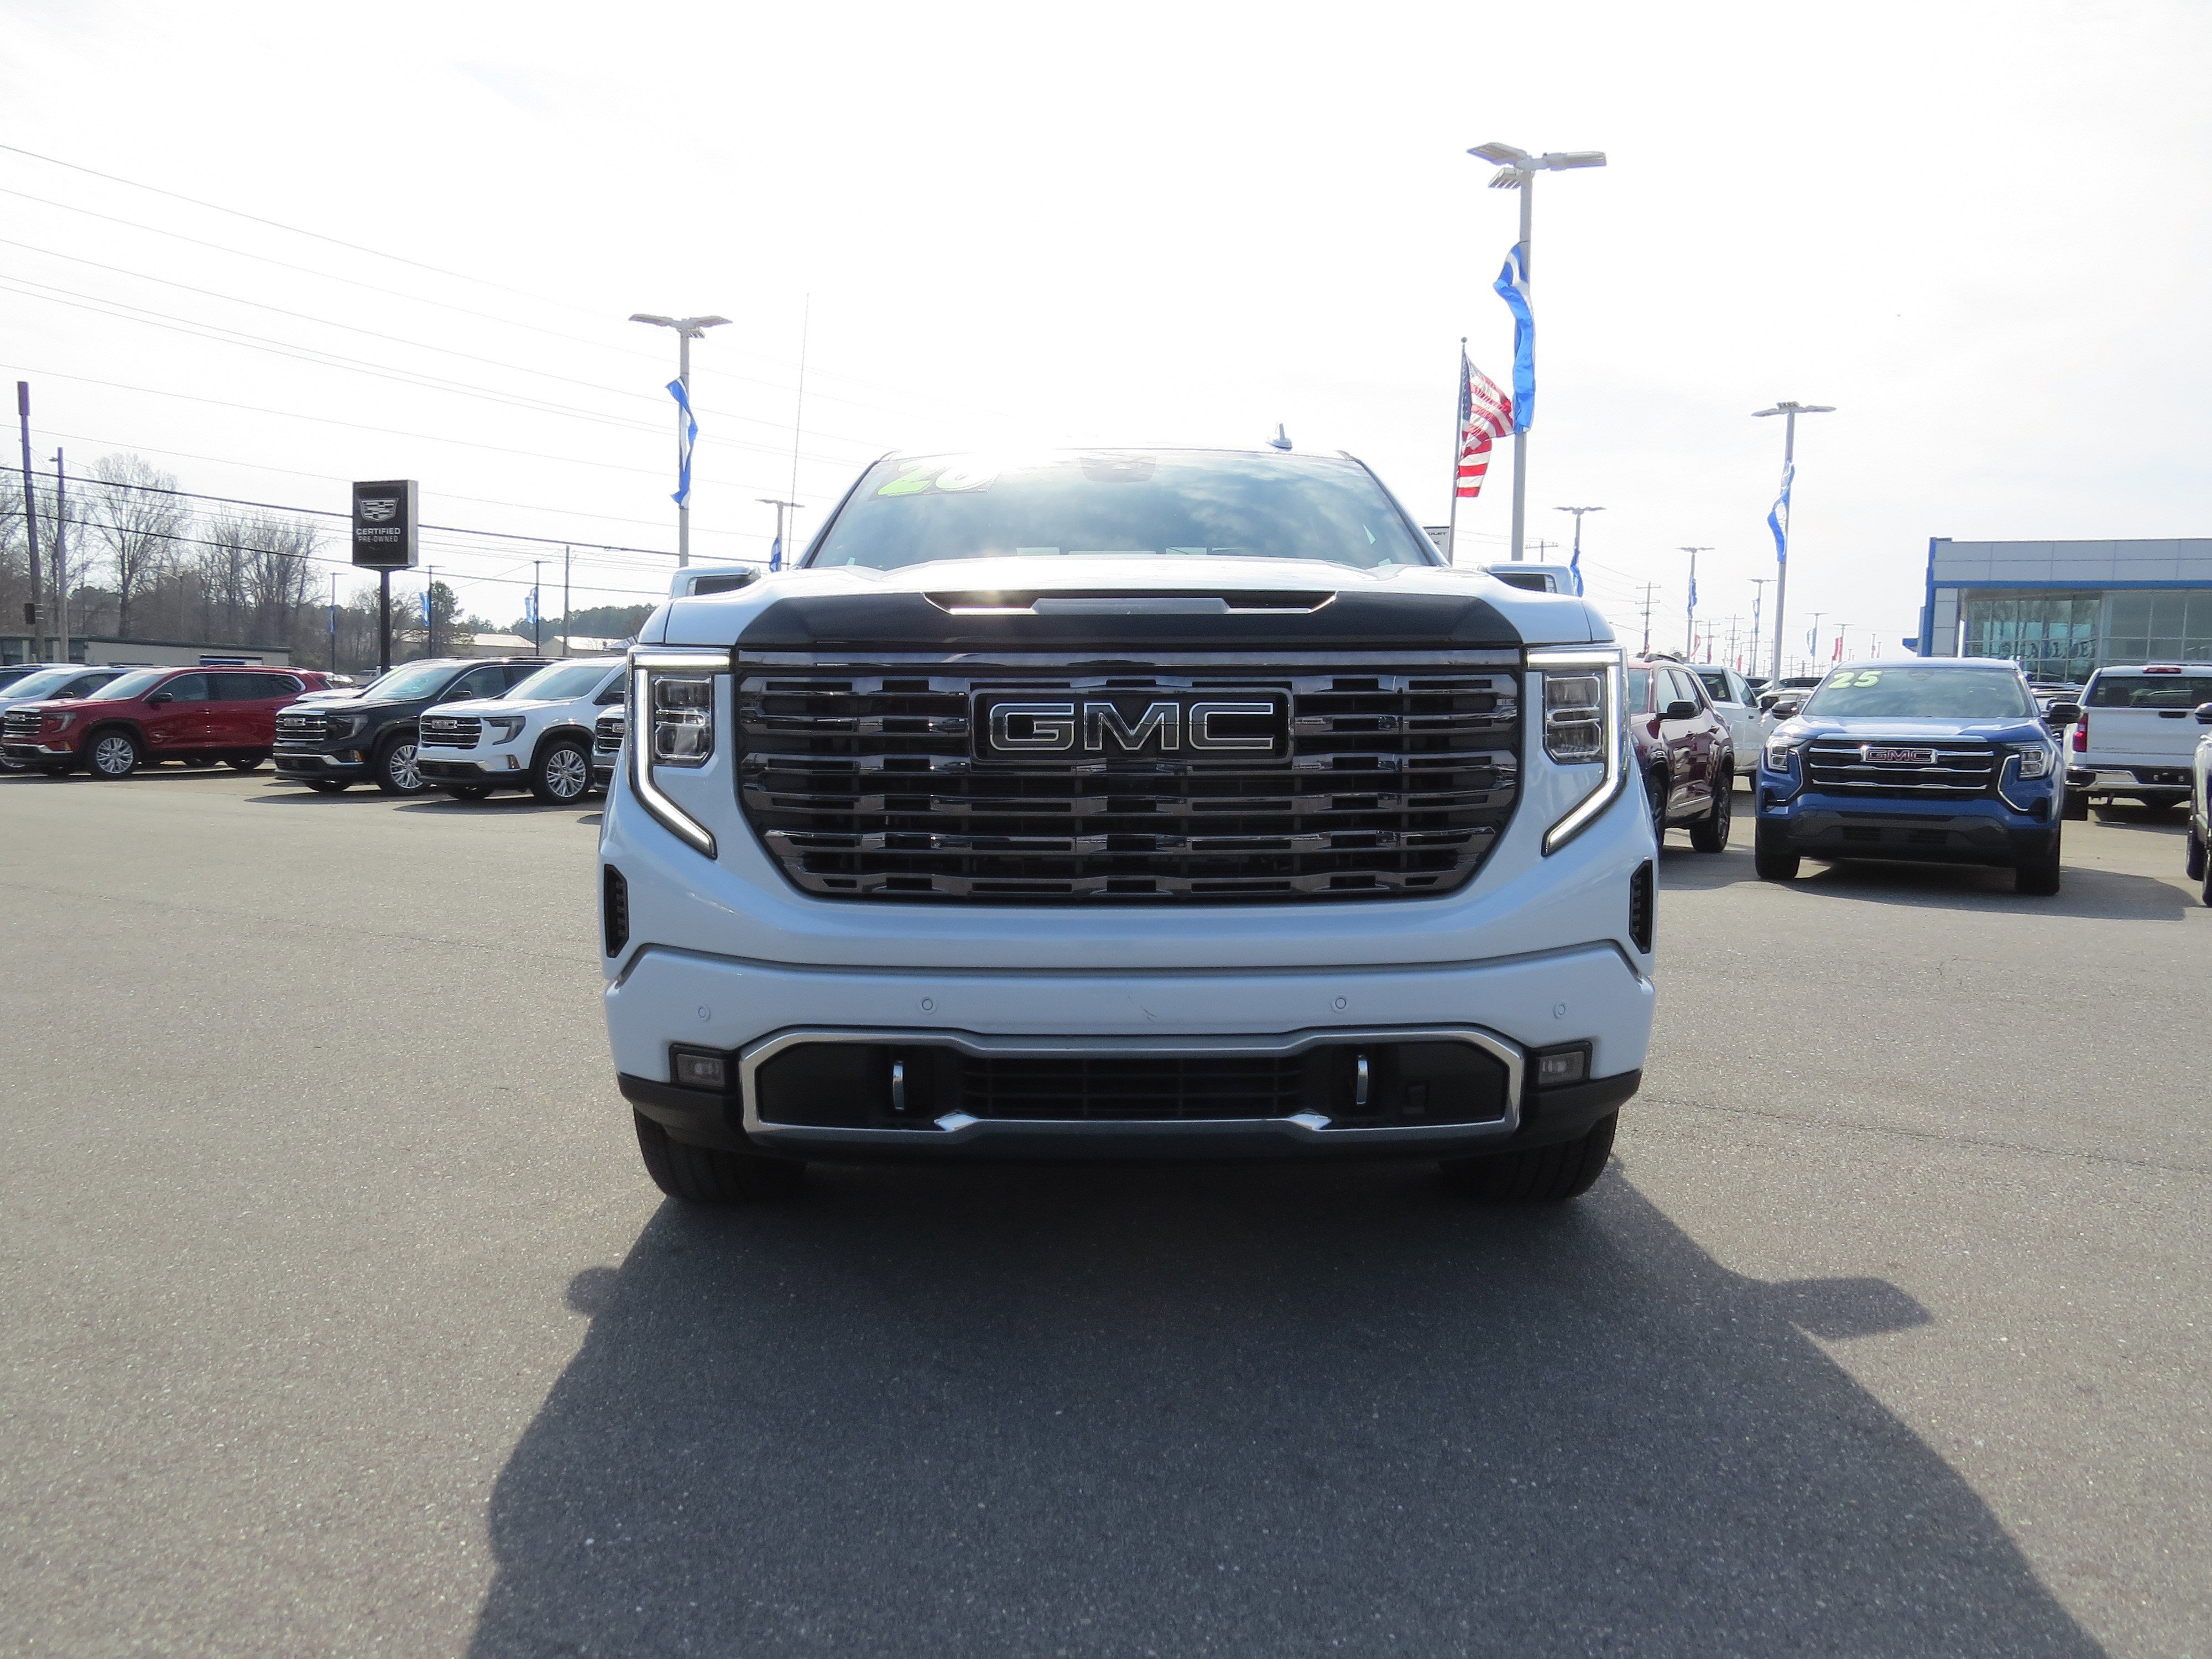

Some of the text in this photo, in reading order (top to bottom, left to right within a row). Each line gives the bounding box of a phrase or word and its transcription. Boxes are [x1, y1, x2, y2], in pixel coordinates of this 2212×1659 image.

[356, 527, 401, 535] CERTIFIED
[1828, 671, 1884, 690] 25
[989, 702, 1274, 751] GMC
[1866, 749, 1932, 762] GMC
